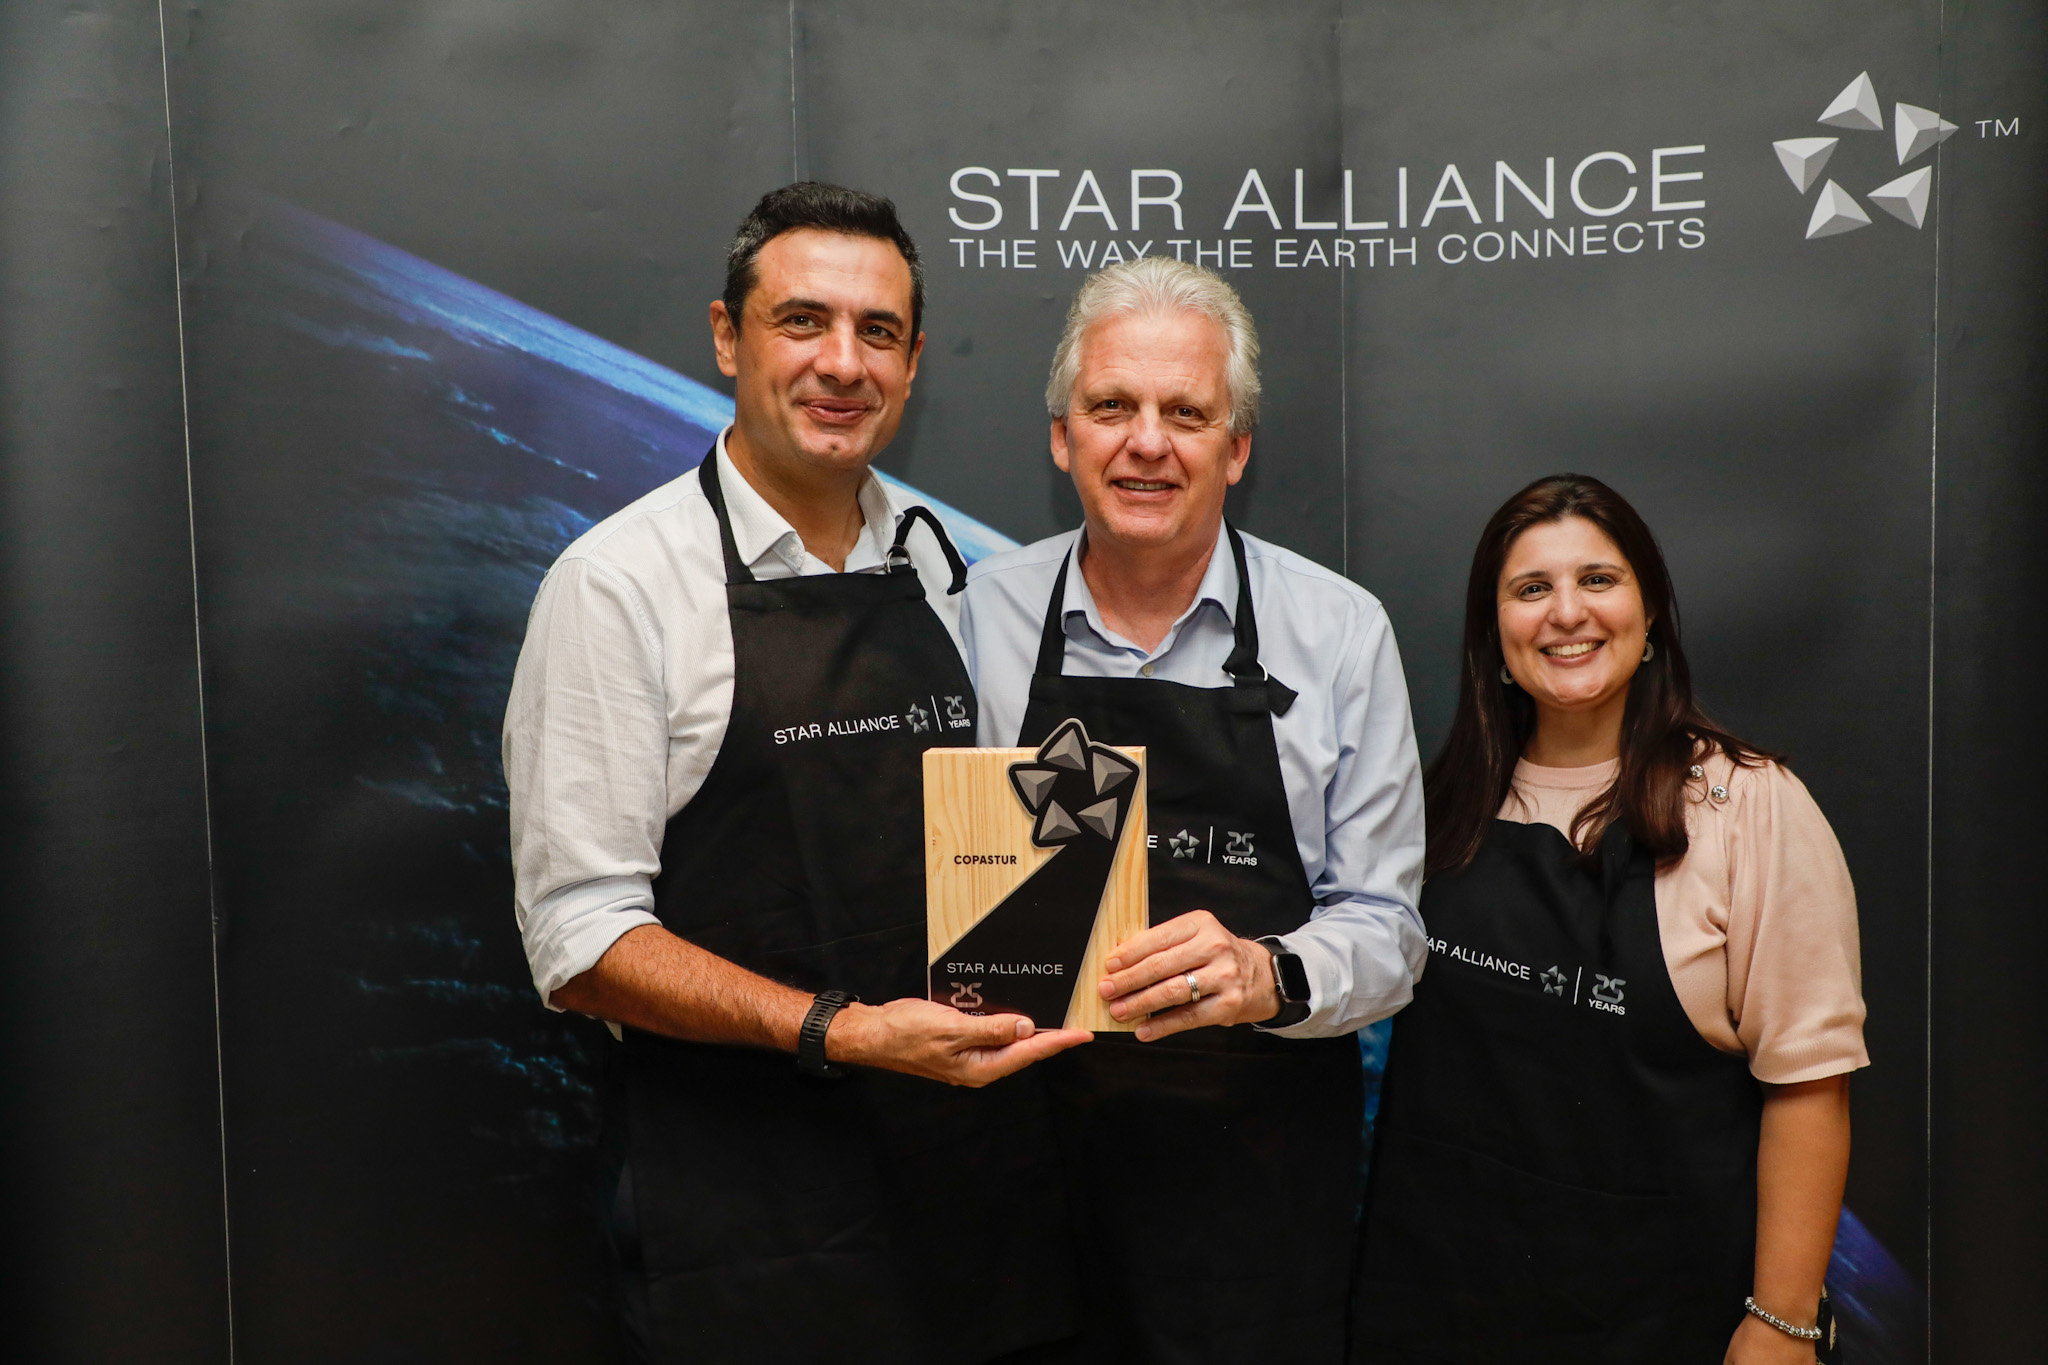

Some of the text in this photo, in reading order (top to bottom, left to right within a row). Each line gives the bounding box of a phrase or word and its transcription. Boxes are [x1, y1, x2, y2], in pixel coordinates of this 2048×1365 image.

[1974, 117, 2019, 138] TM
[949, 145, 1706, 231] STAR ALLIANCE
[949, 218, 1706, 268] THE WAY THE EARTH CONNECTS
[774, 715, 900, 745] STAR ALLIANCE
[948, 719, 971, 729] YEARS
[954, 855, 1017, 865] COPASTUR
[1222, 855, 1258, 866] YEARS
[1426, 936, 1531, 981] AR ALLIANCE
[946, 962, 1064, 975] STAR ALLIANCE
[1588, 998, 1626, 1016] YEARS
